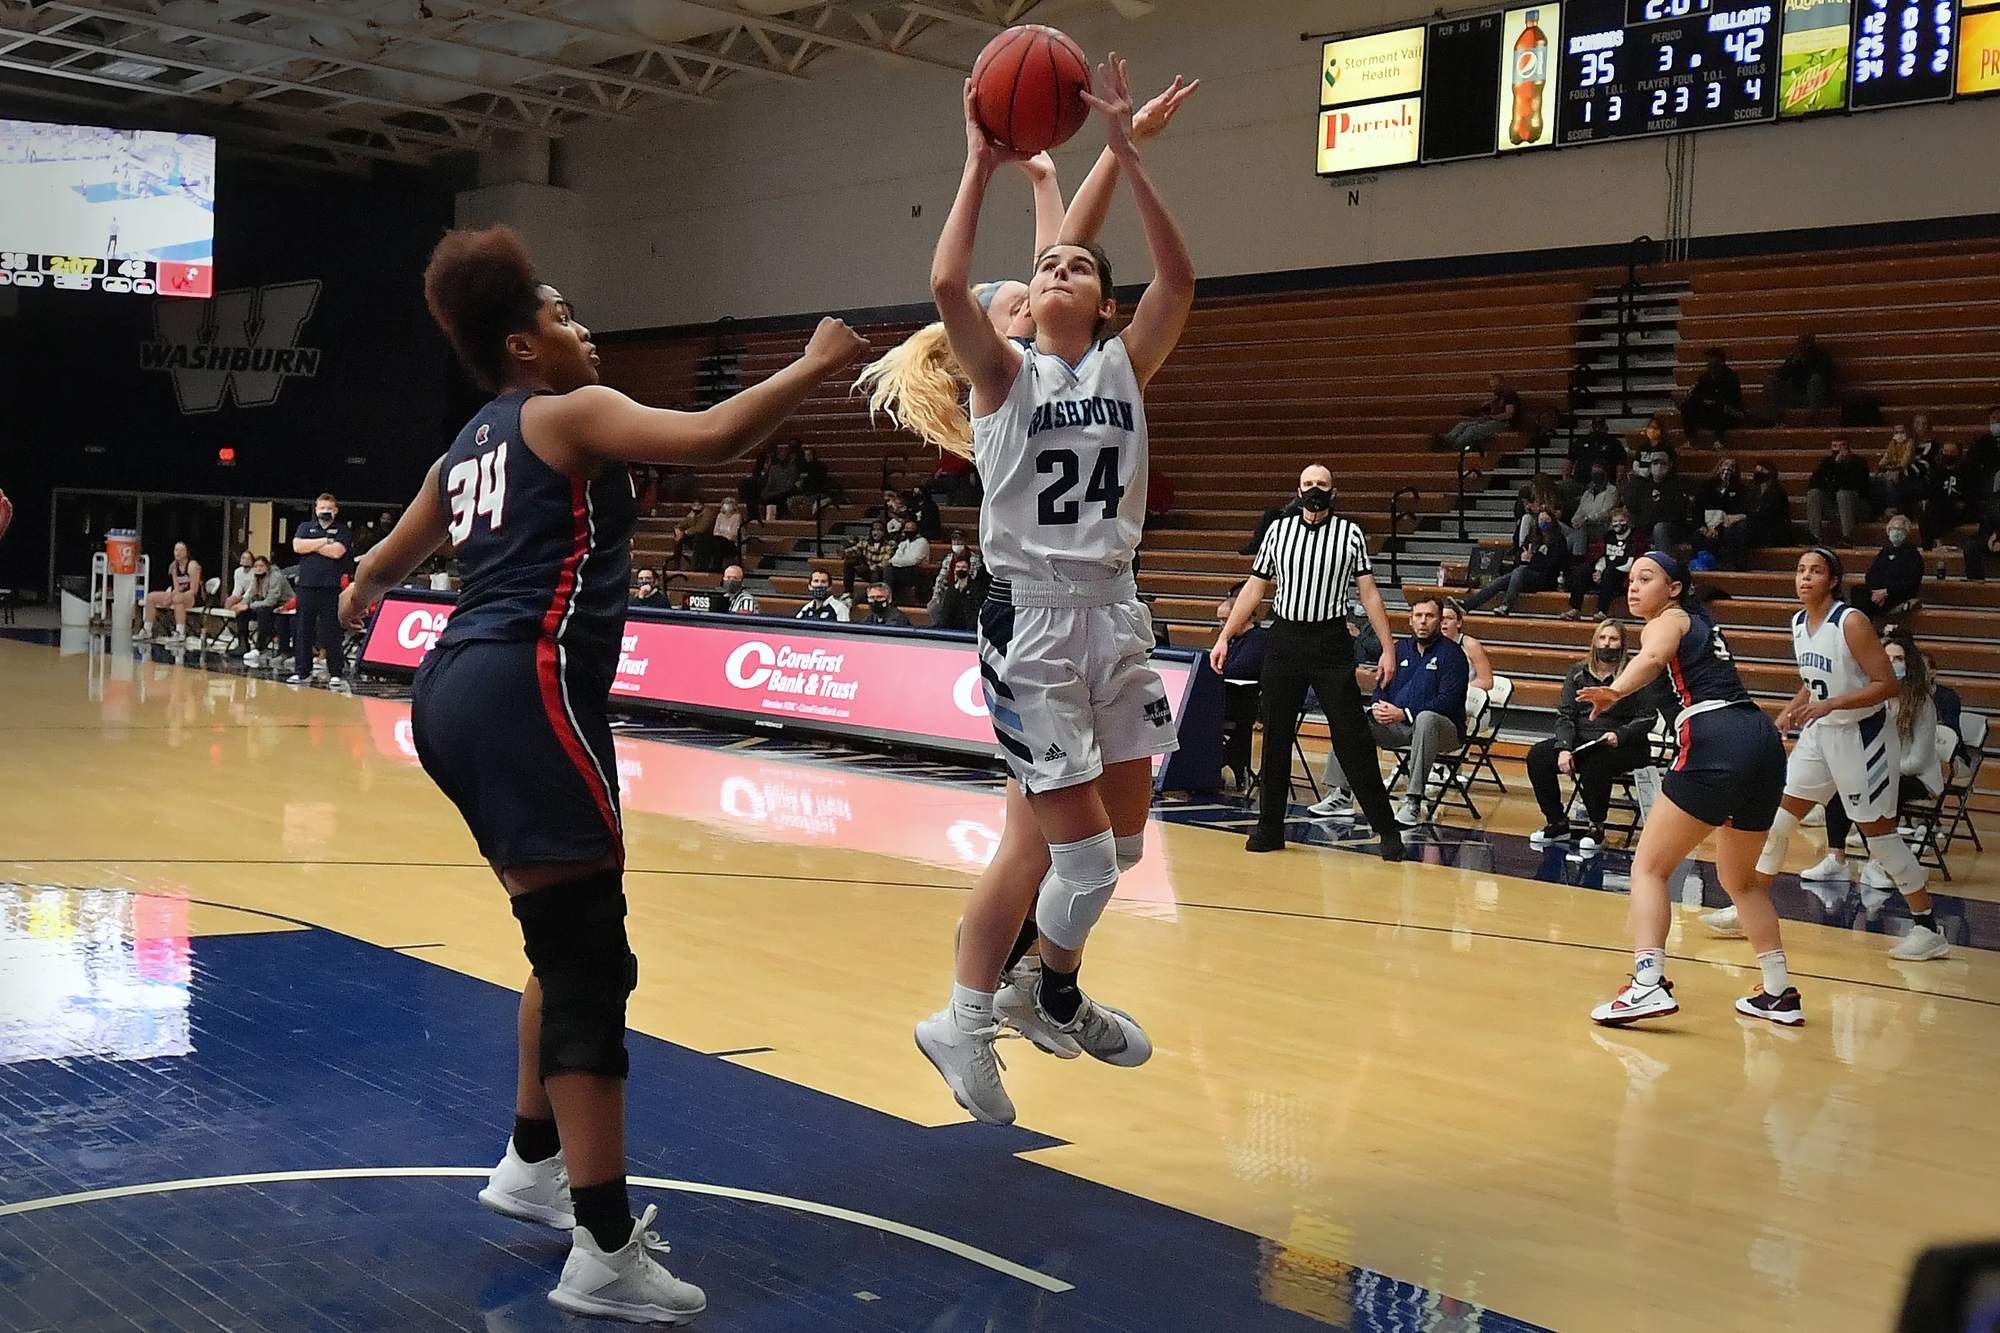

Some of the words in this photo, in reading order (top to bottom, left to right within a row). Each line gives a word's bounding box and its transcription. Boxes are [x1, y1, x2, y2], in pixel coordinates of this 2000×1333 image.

[1862, 11, 1887, 34] 12
[1935, 1, 1951, 24] 6
[1651, 29, 1683, 43] PERIOD
[1724, 28, 1765, 63] 42
[1856, 34, 1885, 59] 25
[1345, 51, 1398, 70] Stormont
[1580, 51, 1615, 87] 35
[1658, 45, 1674, 72] 3
[1737, 63, 1766, 77] FOULS
[1855, 59, 1884, 84] 34
[1899, 53, 1917, 77] 2
[1932, 49, 1949, 73] 2
[1362, 66, 1400, 81] Health
[1637, 78, 1670, 91] PLAYER
[1673, 73, 1694, 86] FOUL
[1569, 87, 1596, 100] FOULS
[1706, 81, 1721, 109] 3
[1745, 77, 1762, 100] 4
[1584, 101, 1592, 123] 1
[1607, 95, 1622, 121] 3
[1323, 104, 1412, 150] Parrish
[1567, 128, 1594, 141] SCORE
[1647, 117, 1678, 131] MATCH
[1733, 107, 1763, 120] SCORE
[911, 206, 921, 218] M
[1348, 190, 1359, 206] N
[50, 256, 98, 275] 2:07
[118, 259, 147, 278] 42
[141, 343, 320, 375] WASHBURN
[447, 440, 508, 547] 34
[1035, 446, 1125, 526] 24
[689, 596, 710, 608] POSS
[777, 645, 845, 673] CoreFirst
[767, 669, 806, 695] Bank
[804, 673, 819, 696] &
[819, 674, 859, 700] Trust
